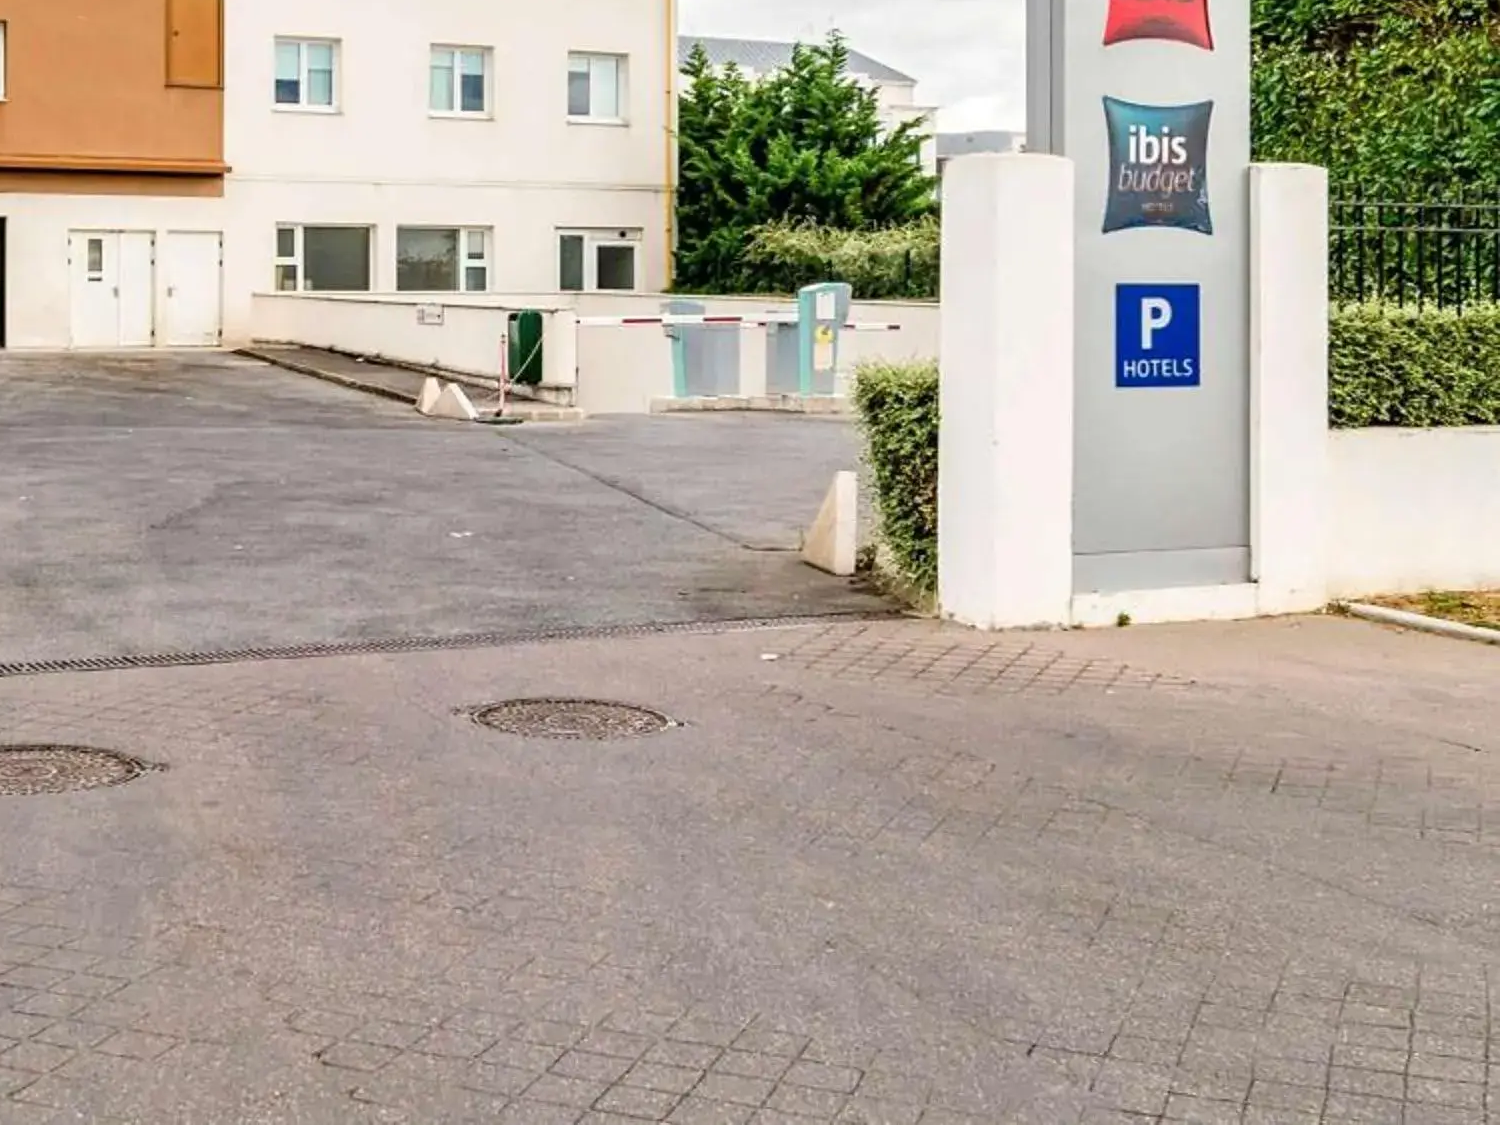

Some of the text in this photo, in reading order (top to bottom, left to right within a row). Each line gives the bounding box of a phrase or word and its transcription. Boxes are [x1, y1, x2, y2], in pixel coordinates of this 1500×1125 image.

[1129, 125, 1187, 164] ibis
[1118, 163, 1195, 199] budget
[1141, 297, 1172, 350] P
[1123, 358, 1193, 377] HOTELS
